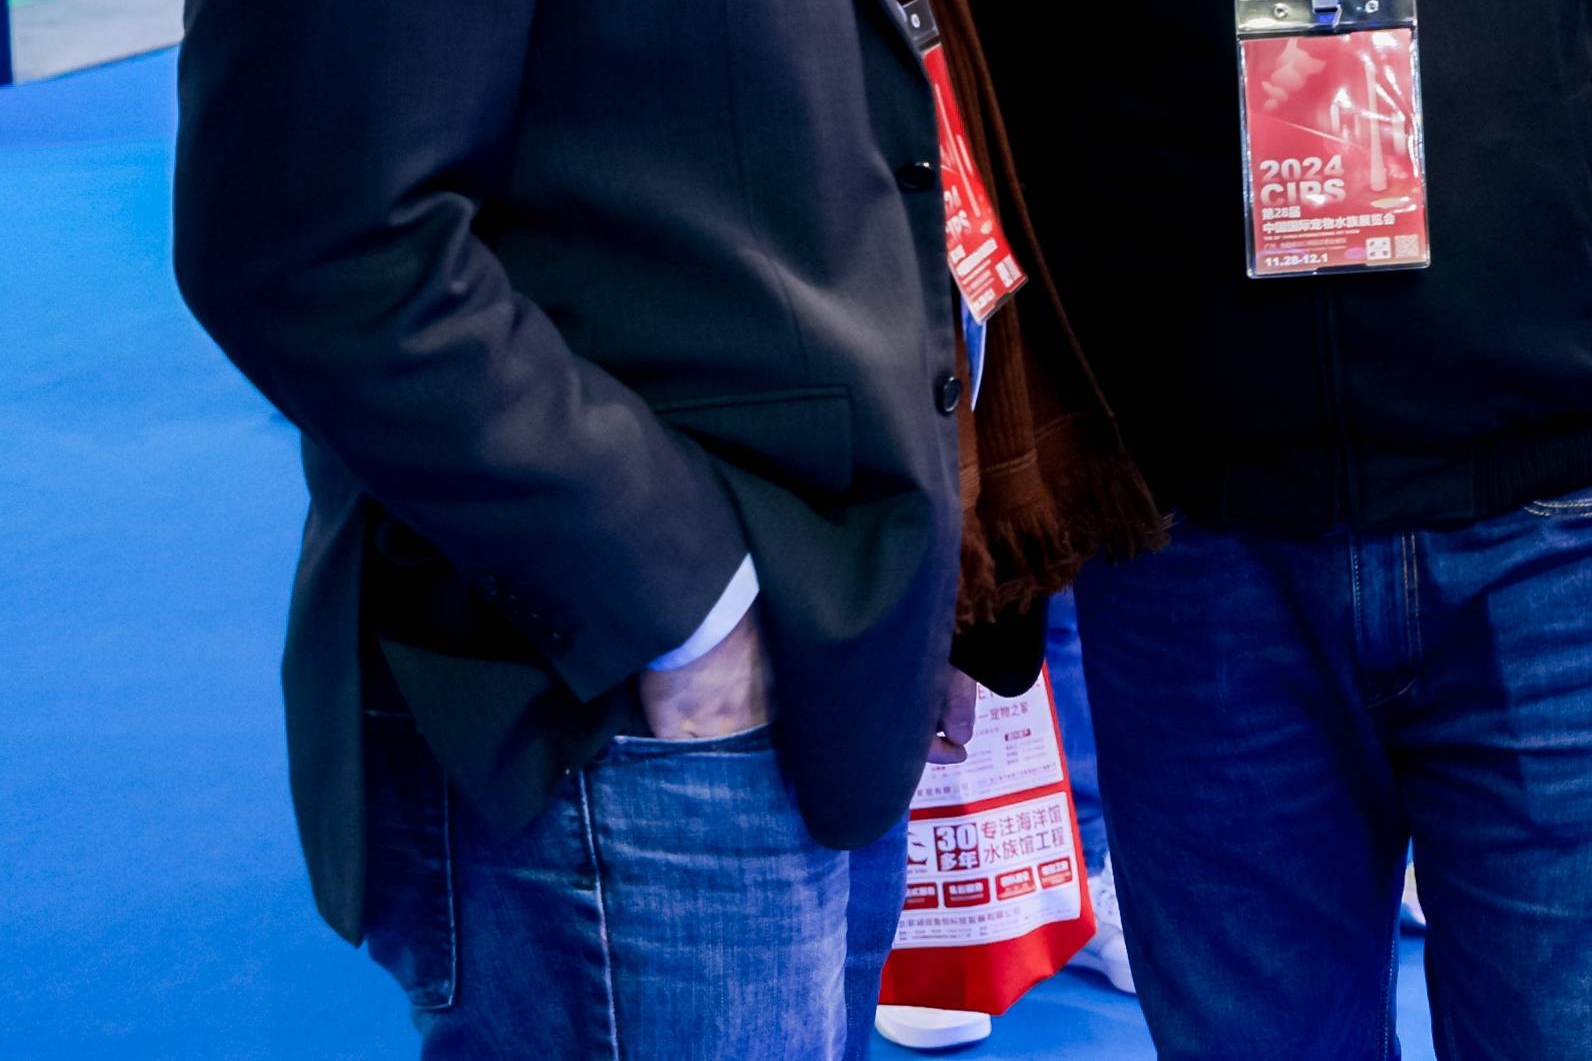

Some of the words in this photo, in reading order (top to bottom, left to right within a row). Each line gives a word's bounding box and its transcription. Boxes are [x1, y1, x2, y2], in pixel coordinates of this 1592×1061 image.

[1259, 154, 1345, 182] 2024
[1259, 178, 1346, 206] CIPS
[981, 804, 1065, 839] 专注海洋馆
[936, 823, 979, 853] 30
[983, 826, 1066, 865] 水族馆工程
